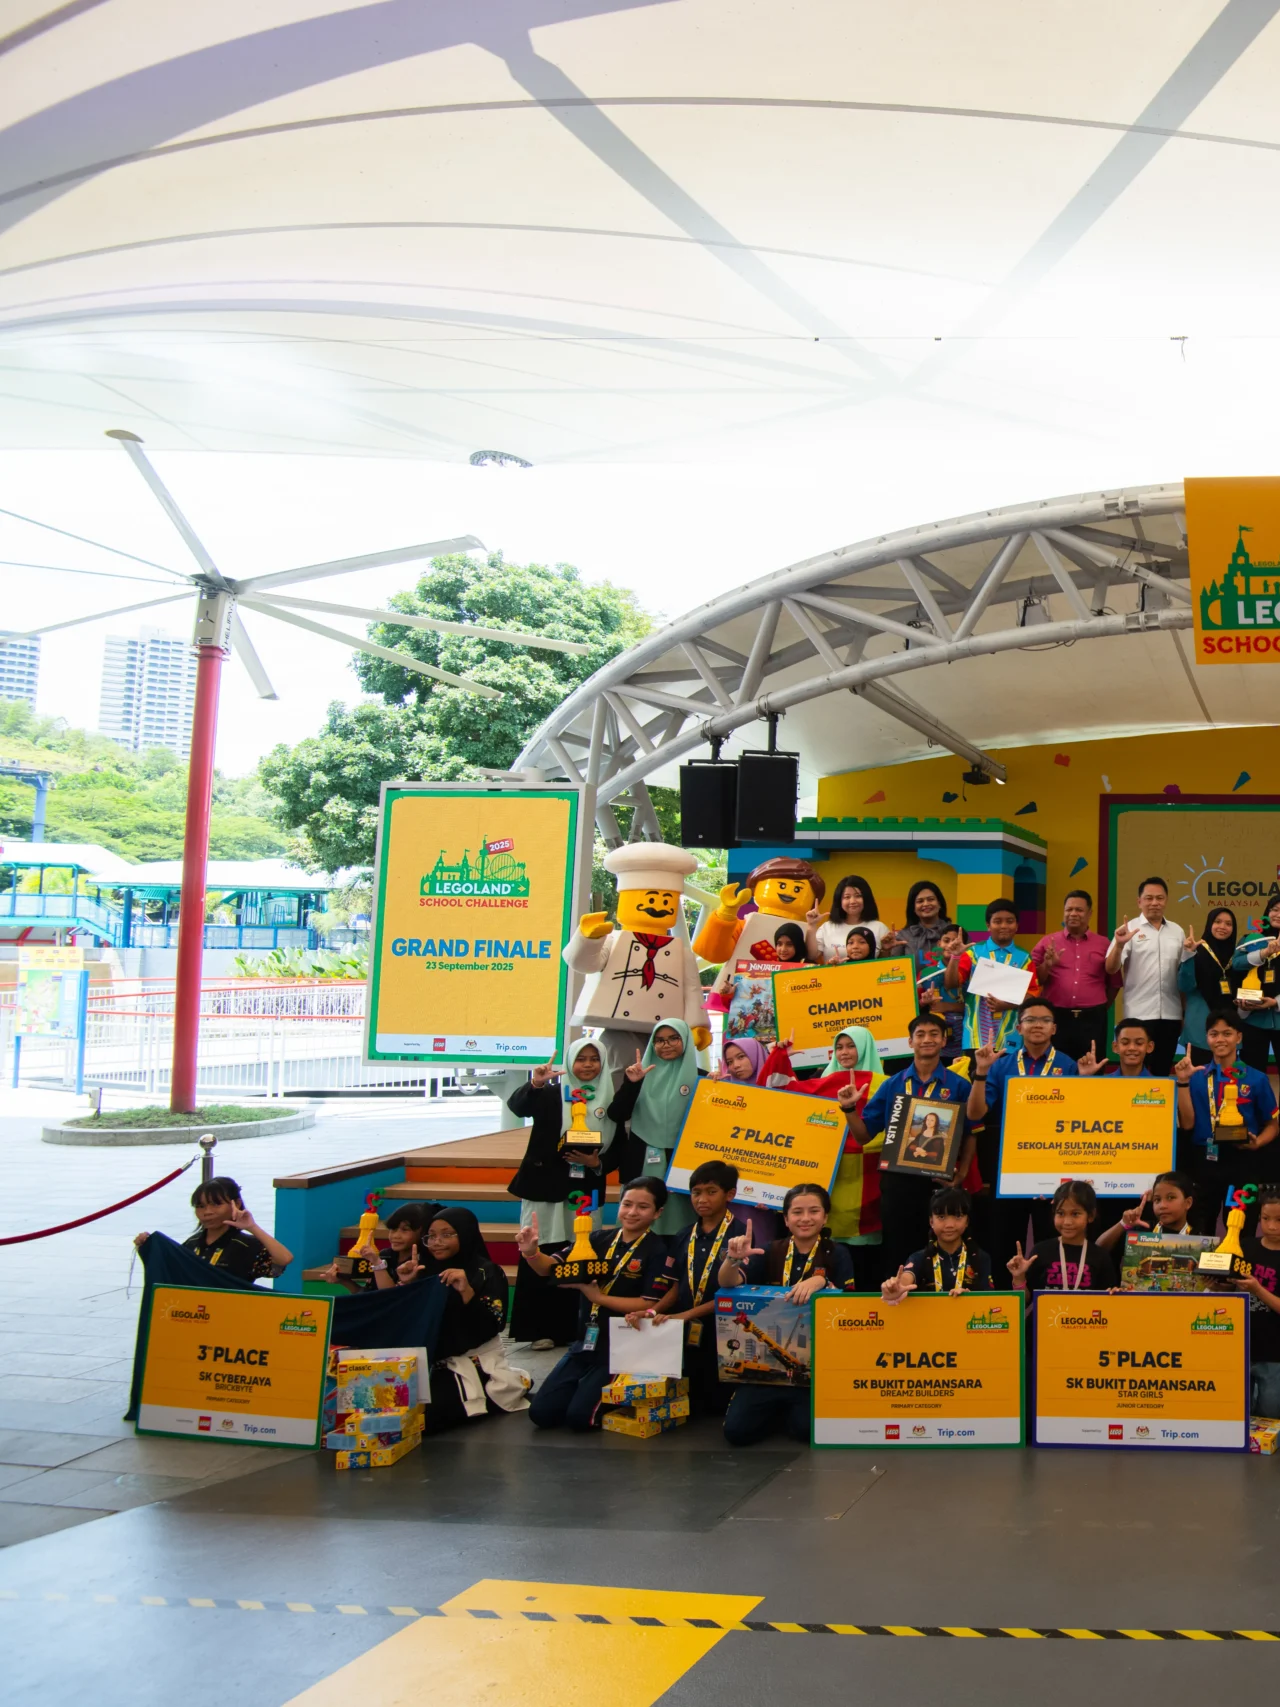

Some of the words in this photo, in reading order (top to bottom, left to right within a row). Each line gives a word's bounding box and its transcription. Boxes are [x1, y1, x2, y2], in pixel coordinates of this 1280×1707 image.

[489, 840, 510, 852] 2025
[435, 882, 514, 895] LEGOLAND
[420, 898, 462, 907] SCHOOL
[465, 899, 528, 908] CHALLENGE
[1207, 899, 1260, 907] MALAYSIA
[1248, 916, 1270, 933] LSC
[391, 938, 470, 957] GRAND
[474, 940, 551, 958] FINALE
[426, 962, 437, 970] 23
[439, 962, 489, 972] September
[491, 963, 513, 971] 2025
[808, 997, 883, 1016] CHAMPION
[824, 1019, 845, 1028] PORT
[847, 1015, 882, 1025] DICKSON
[496, 1043, 527, 1052] Trip.com
[1217, 1061, 1247, 1084] LSC
[564, 1085, 595, 1104] LSC
[712, 1097, 747, 1108] LEGOLAND
[891, 1096, 904, 1123] MONA
[811, 1118, 834, 1126] LEGOLAND
[1071, 1121, 1123, 1133] PLACE
[744, 1130, 795, 1148] PLACE
[885, 1125, 897, 1145] LISA
[1018, 1142, 1062, 1150] SEKOLAH
[1064, 1142, 1100, 1150] SULTAN
[1102, 1142, 1129, 1150] ALAM
[1132, 1142, 1158, 1150] SHAH
[694, 1141, 731, 1153] SEKOLAH
[732, 1148, 777, 1162] MENENGAH
[778, 1156, 819, 1168] SETIABUDI
[740, 1156, 764, 1166] BLOCKS
[764, 1161, 786, 1169] AHEAD
[1225, 1184, 1258, 1210] LSC
[736, 1301, 755, 1310] CITY
[171, 1311, 210, 1320] LEGOLAND
[839, 1319, 884, 1327] LEGOLAND
[213, 1347, 269, 1366] PLACE
[893, 1352, 957, 1368] PLACE
[1118, 1352, 1182, 1368] PLACE
[199, 1372, 212, 1381] SK
[214, 1373, 271, 1387] CYBERJAYA
[853, 1379, 868, 1389] SK
[871, 1379, 905, 1389] BUKIT
[907, 1379, 982, 1389] DAMANSARA
[1066, 1378, 1083, 1389] SK
[1086, 1379, 1126, 1390] BUKIT
[1128, 1380, 1216, 1391] DAMANSARA
[215, 1383, 253, 1393] BRICKBYTE
[1140, 1391, 1163, 1399] GIRLS
[244, 1424, 276, 1434] Trip.com
[938, 1428, 975, 1438] Trip.com
[1161, 1430, 1199, 1439] Trip.com
